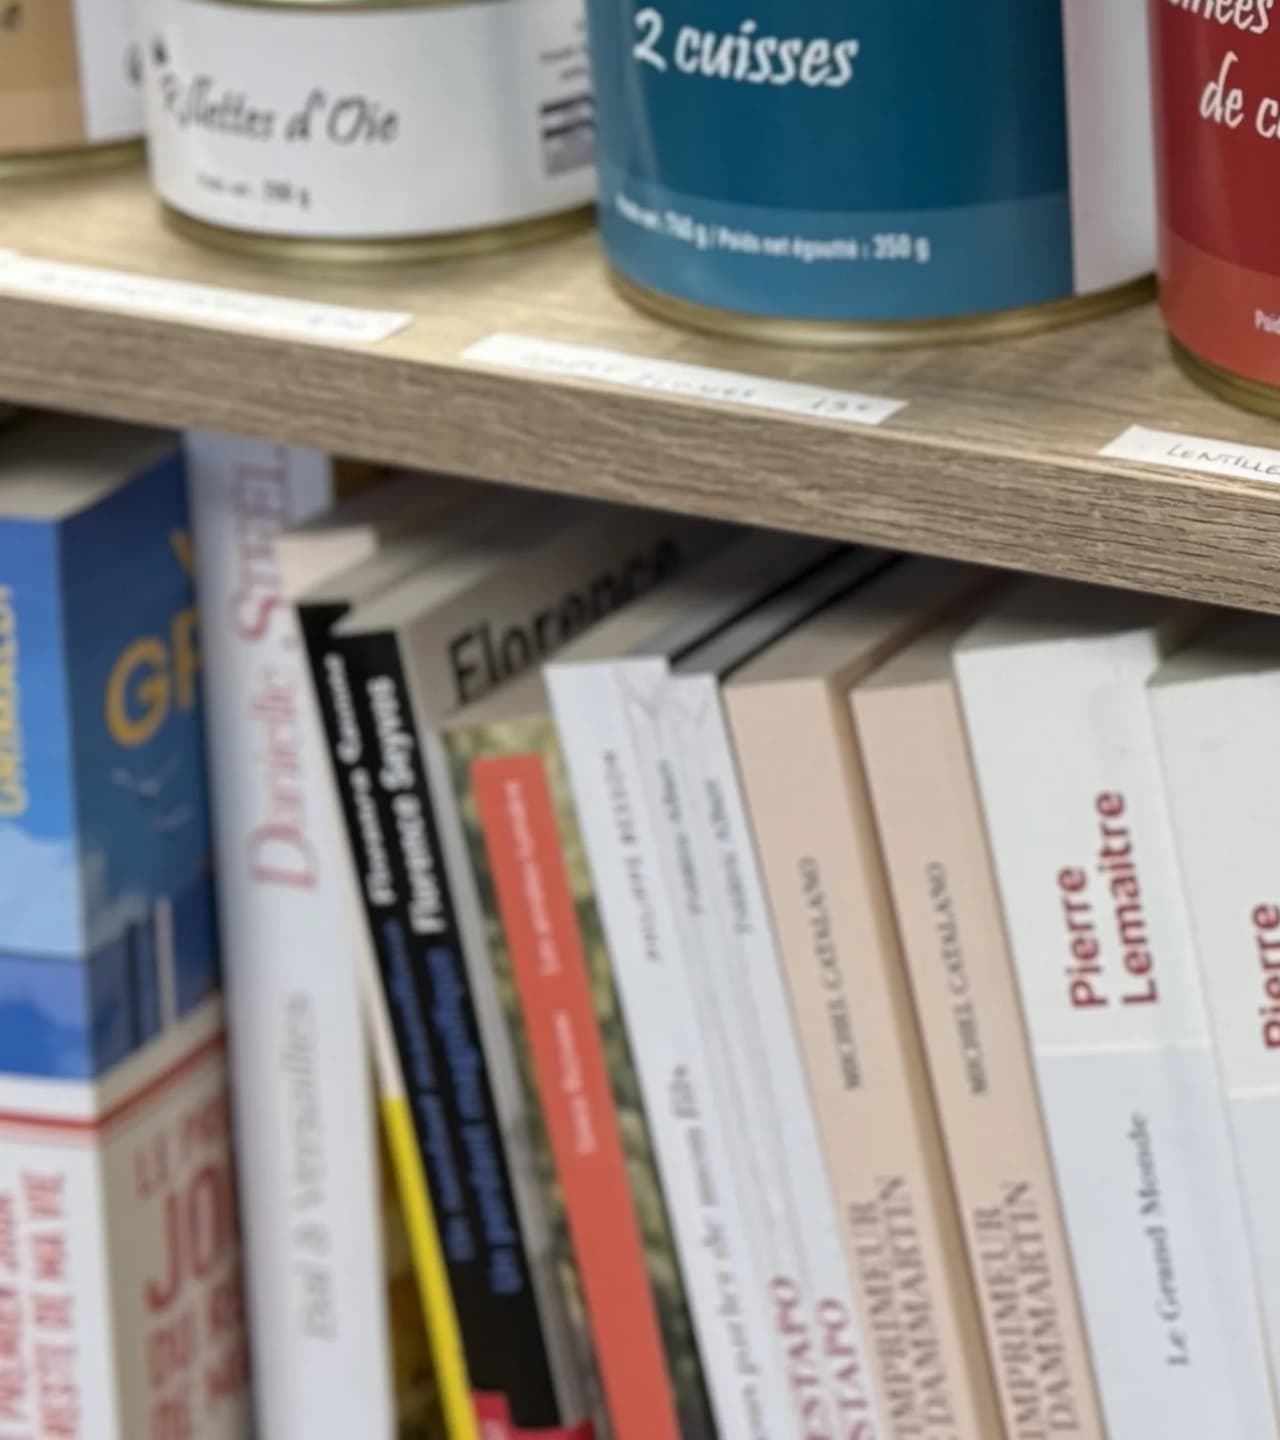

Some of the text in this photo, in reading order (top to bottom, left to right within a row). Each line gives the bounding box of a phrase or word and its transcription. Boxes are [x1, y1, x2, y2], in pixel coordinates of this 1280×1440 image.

[633, 8, 860, 87] 2 cuisses
[1199, 50, 1245, 129] de
[394, 790, 447, 934] Florence
[1095, 789, 1158, 1007] Lemaitre
[1055, 864, 1109, 1010] Pierre
[1130, 1112, 1168, 1220] Monde
[1155, 1224, 1188, 1331] Grand
